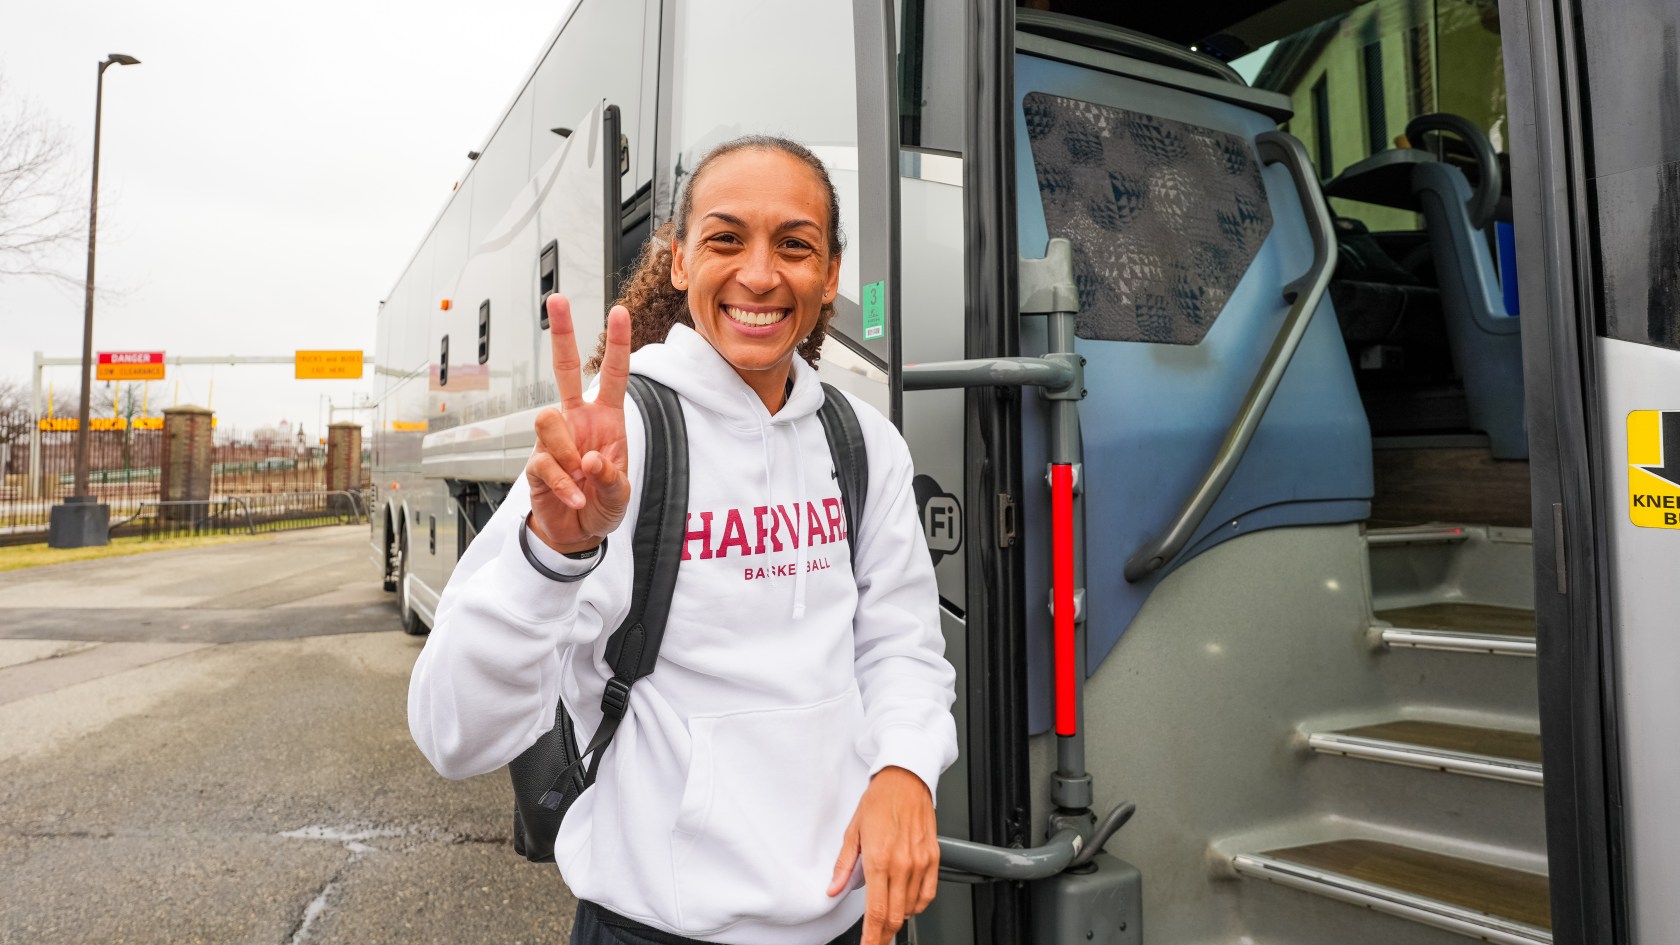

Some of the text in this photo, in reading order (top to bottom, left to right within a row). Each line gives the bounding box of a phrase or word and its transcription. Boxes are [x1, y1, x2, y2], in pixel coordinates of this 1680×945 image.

[870, 287, 877, 305] 3
[111, 354, 151, 363] DANGER
[1633, 494, 1680, 509] KNE
[930, 505, 954, 539] Fi
[1664, 512, 1680, 525] B
